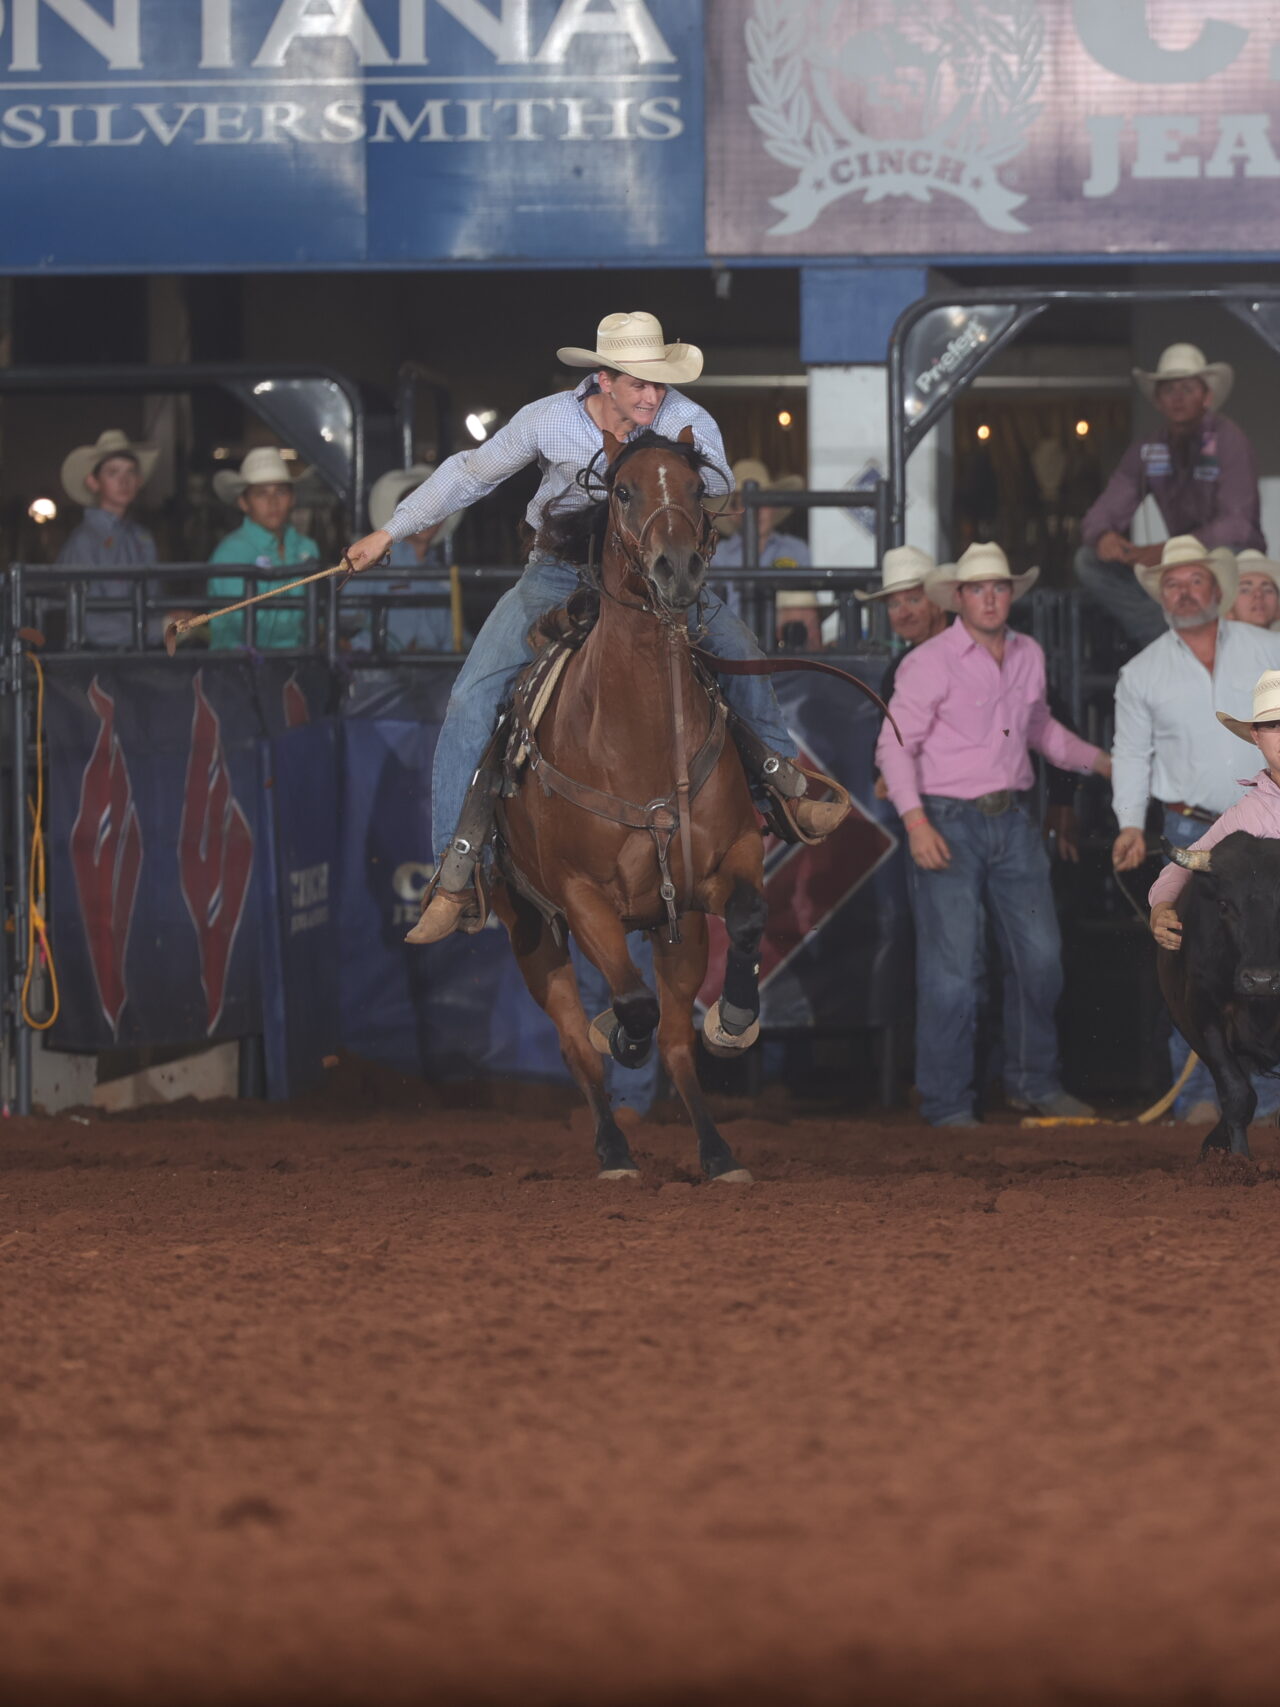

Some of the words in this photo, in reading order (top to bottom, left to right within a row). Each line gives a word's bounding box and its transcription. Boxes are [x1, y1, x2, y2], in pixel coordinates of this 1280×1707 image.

[0, 0, 677, 71] NANA
[0, 97, 685, 148] SILVERSMITHS
[829, 150, 967, 185] CINCH
